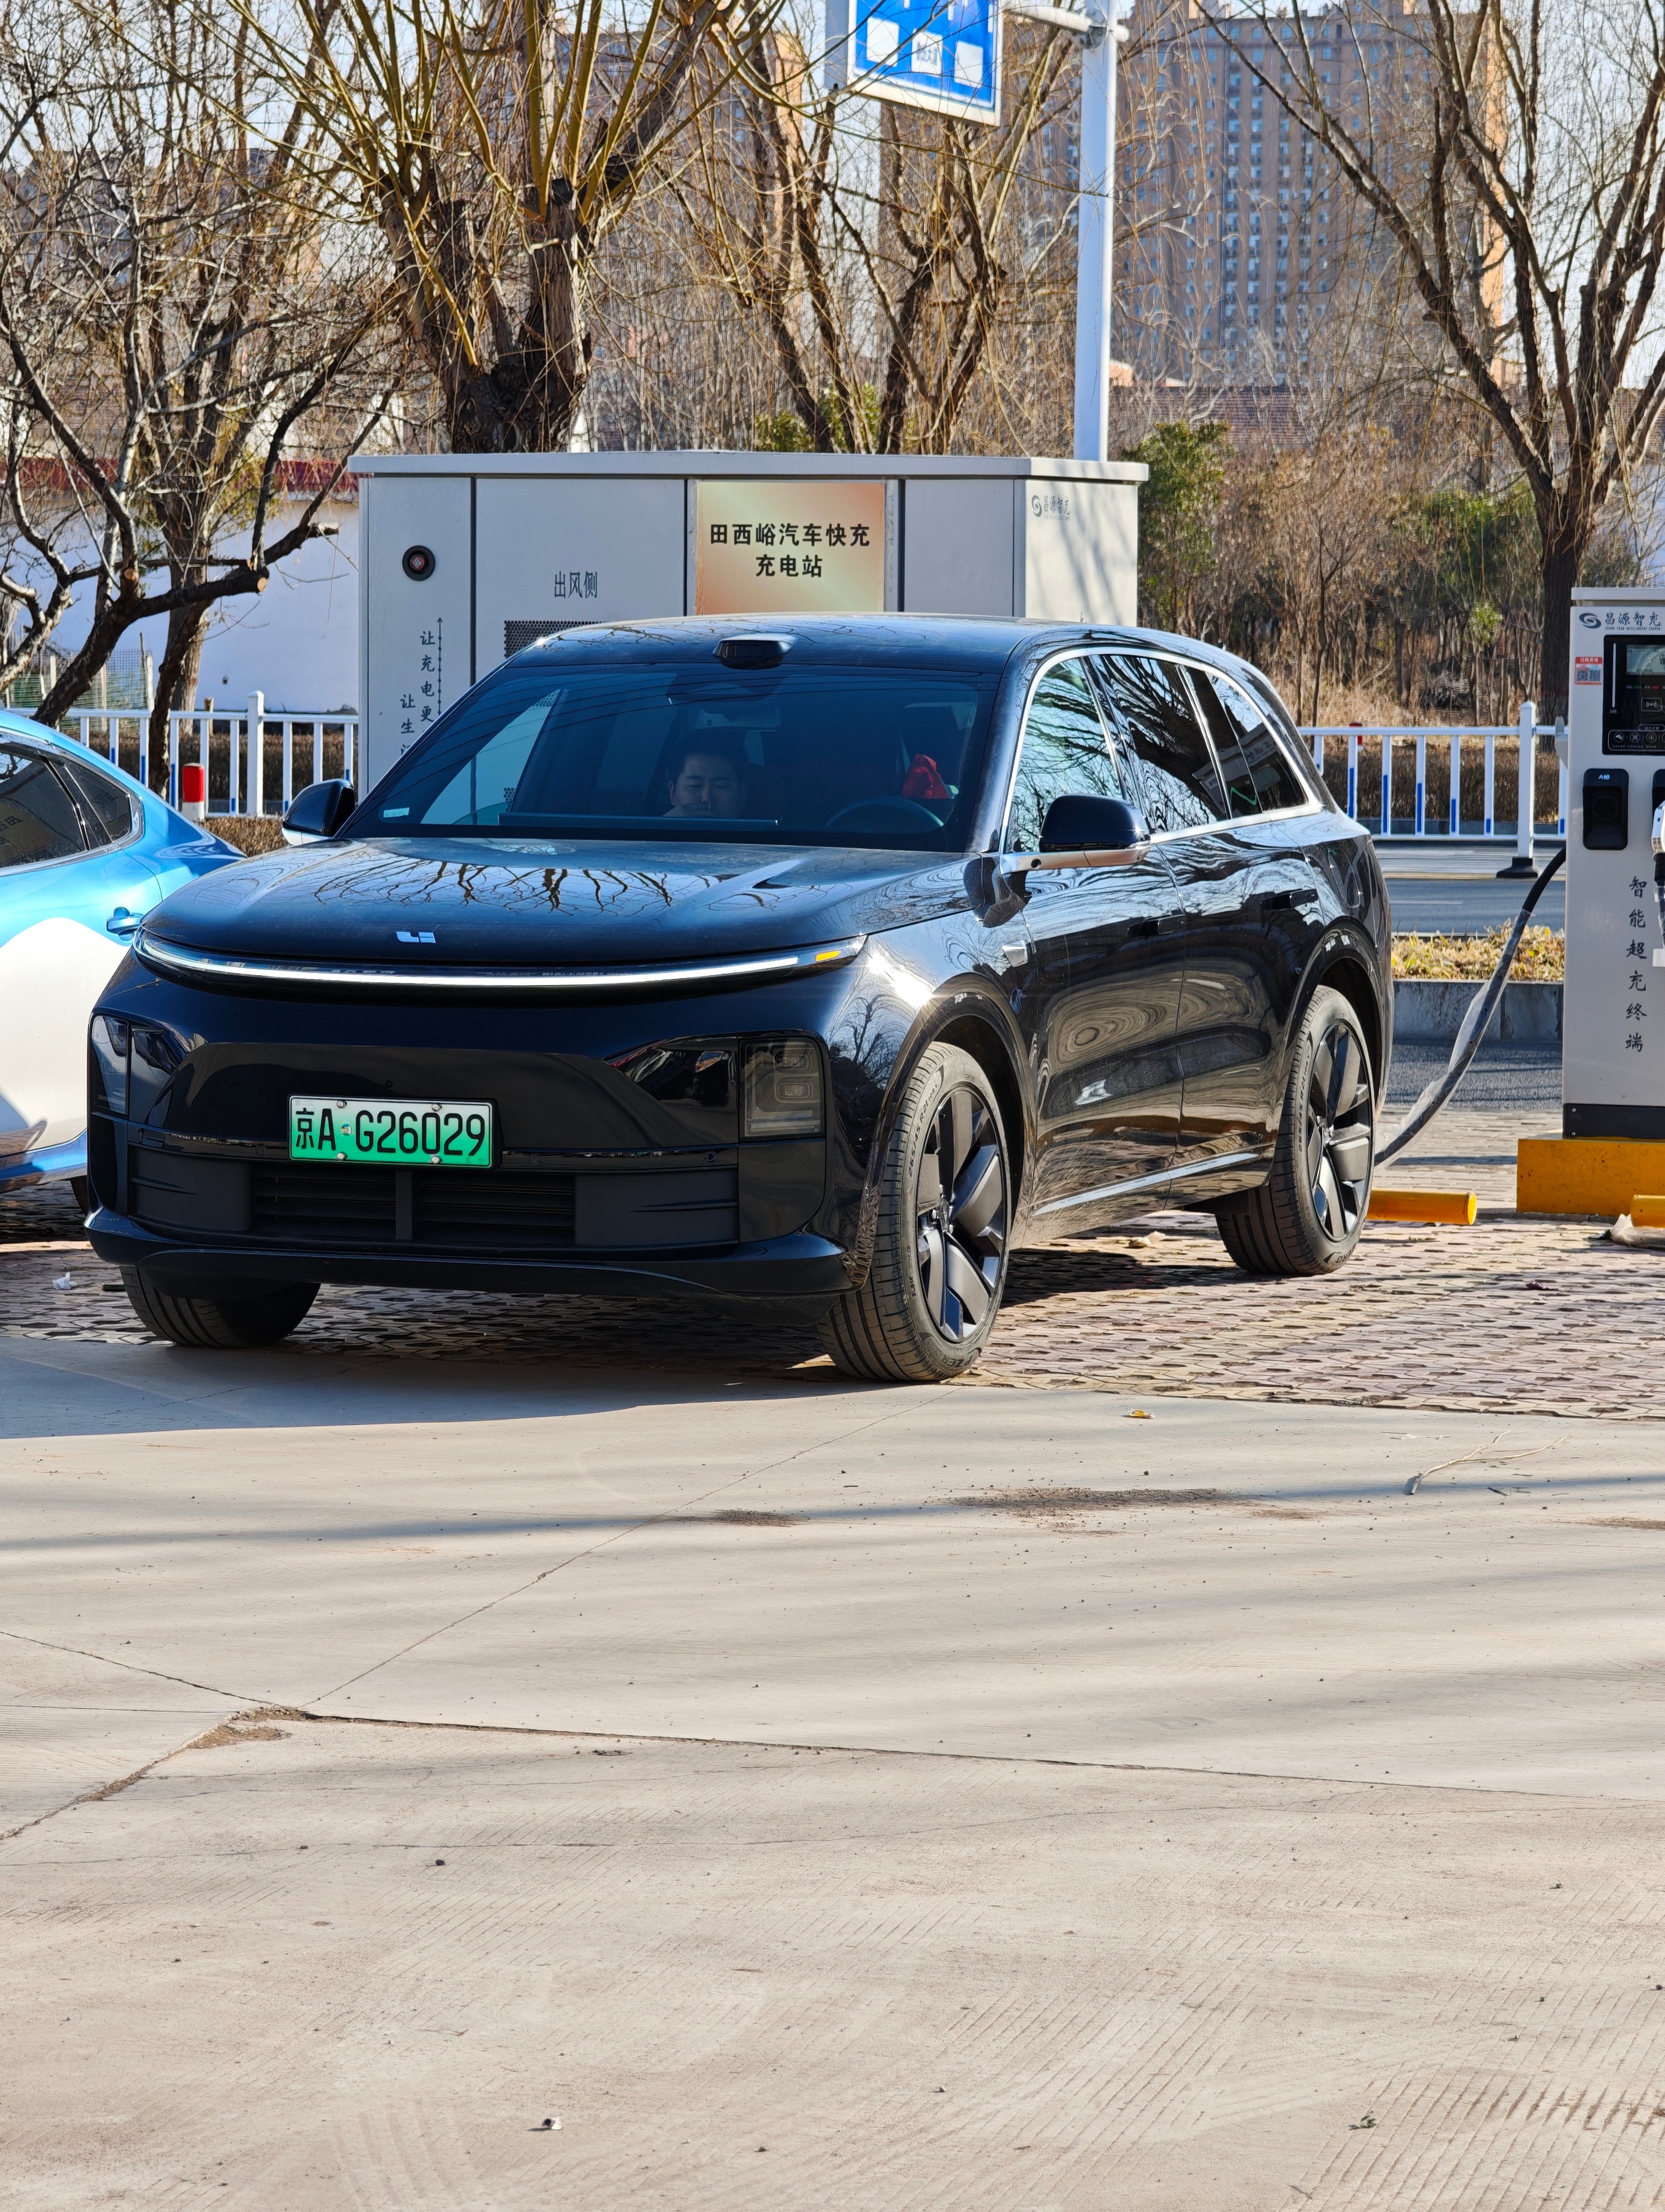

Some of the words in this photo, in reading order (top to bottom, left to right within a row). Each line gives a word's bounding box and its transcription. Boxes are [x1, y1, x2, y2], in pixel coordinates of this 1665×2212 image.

[710, 523, 870, 547] 田西峪汽车快充
[554, 570, 597, 599] 出风侧
[756, 554, 823, 578] 充电站
[1605, 612, 1661, 627] 昌源智充
[420, 631, 436, 732] 让充电更
[1625, 876, 1647, 1052] 智能超充终端
[295, 1107, 336, 1151] 京A
[355, 1110, 486, 1156] G26029
[908, 1124, 921, 1178] 265/45
[920, 1099, 929, 1124] R21
